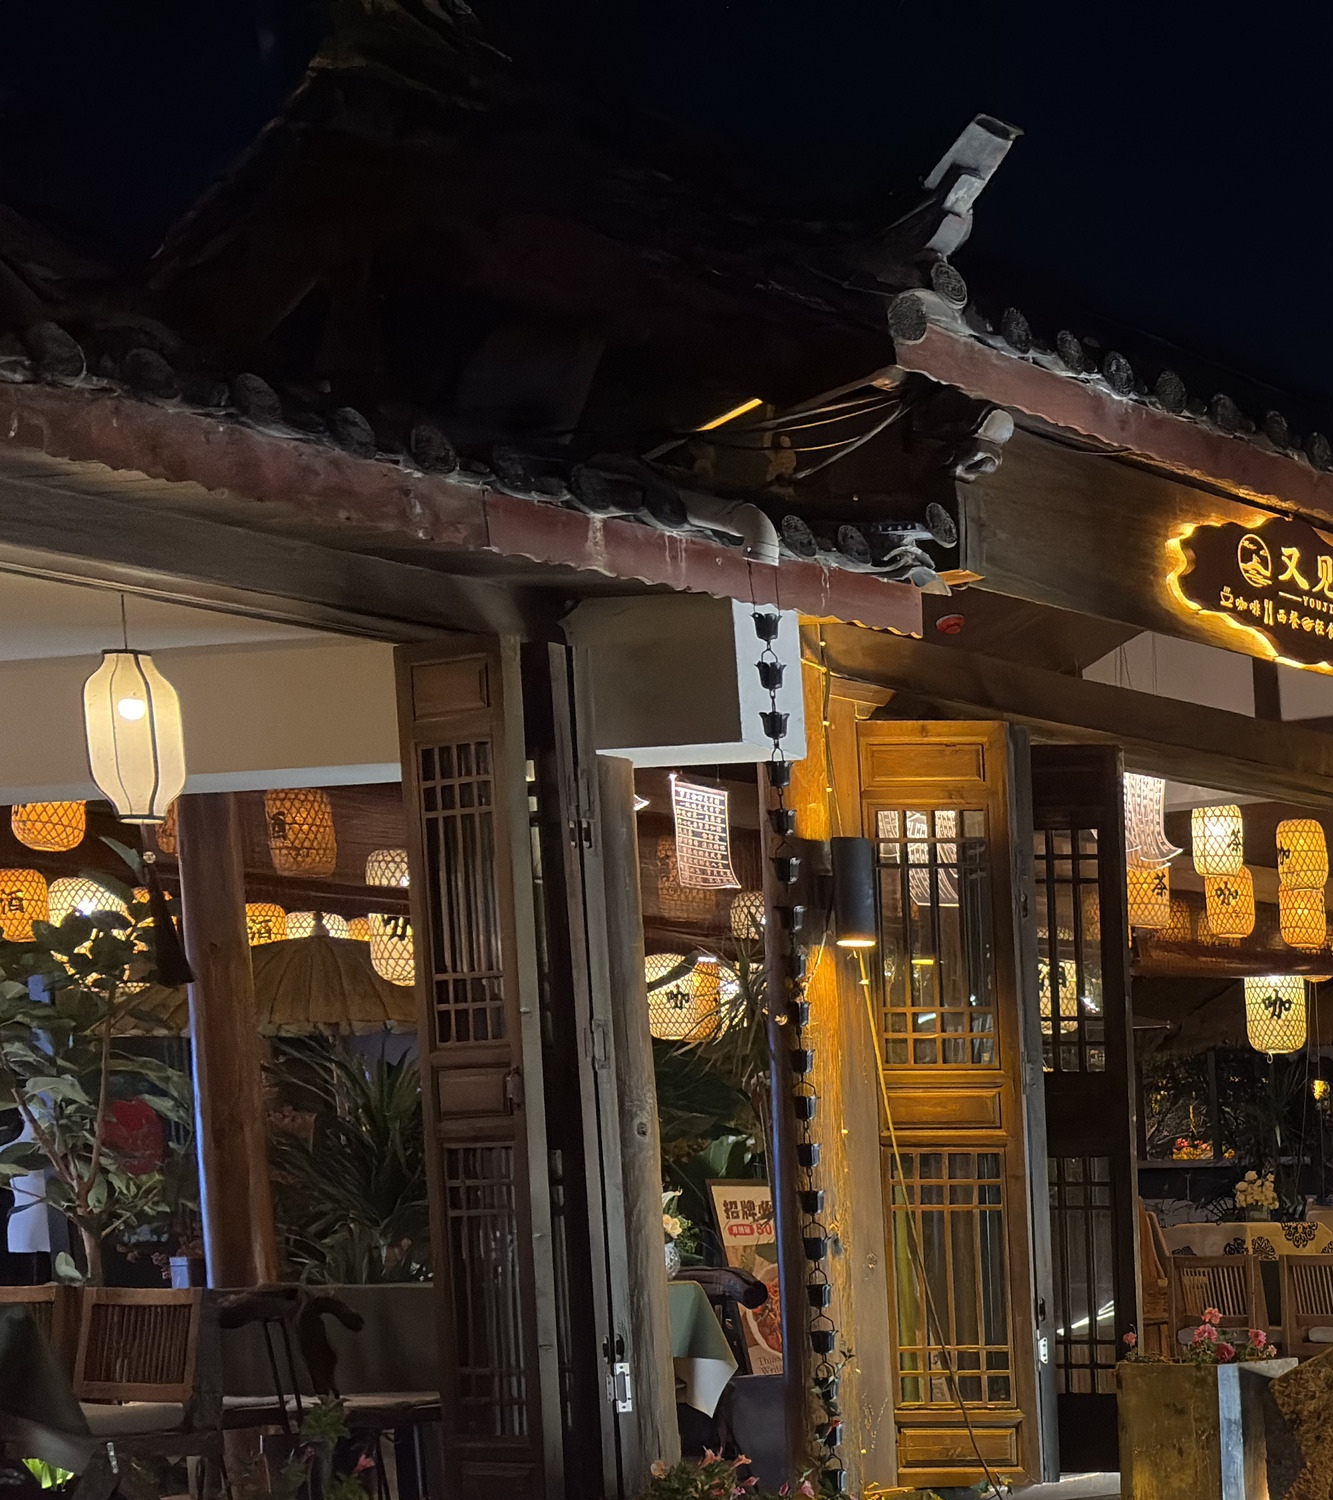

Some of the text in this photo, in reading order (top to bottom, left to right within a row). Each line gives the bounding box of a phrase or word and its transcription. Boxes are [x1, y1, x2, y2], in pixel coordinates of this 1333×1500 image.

[1235, 596, 1261, 617] 咖啡
[1277, 609, 1301, 629] 西餐
[1152, 873, 1168, 897] 茶
[1263, 988, 1293, 1020] 咖
